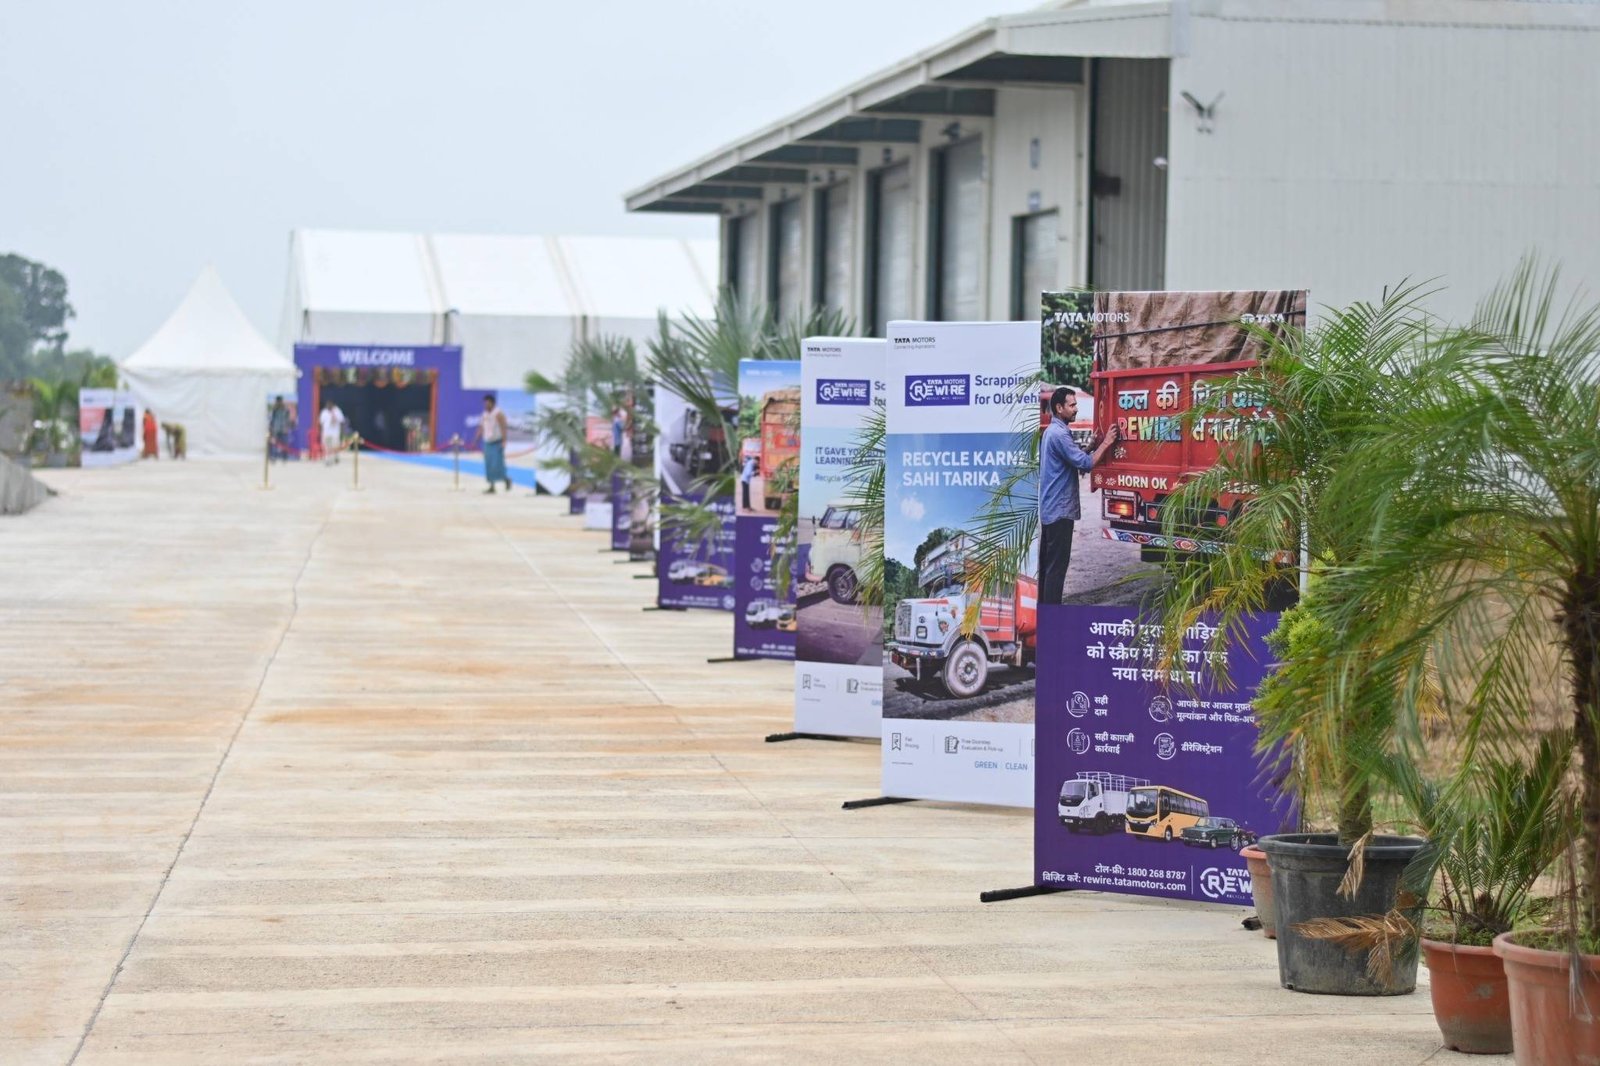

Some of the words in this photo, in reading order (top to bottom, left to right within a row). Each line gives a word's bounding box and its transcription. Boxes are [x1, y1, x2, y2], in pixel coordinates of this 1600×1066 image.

[1054, 312, 1084, 322] TATA
[1087, 312, 1130, 322] MOTORS
[339, 350, 414, 365] WELCOME
[975, 394, 990, 404] for
[994, 393, 1013, 404] Old
[1118, 390, 1149, 410] कल
[1156, 380, 1180, 410] की
[1117, 416, 1181, 441] REWIRE
[815, 447, 822, 455] IT
[824, 447, 847, 456] GAVE
[848, 448, 864, 456] YO
[902, 451, 970, 466] RECYCLE
[902, 472, 940, 487] SAHI
[943, 471, 1001, 486] TARIKA
[1117, 475, 1149, 489] HORN
[1151, 477, 1168, 490] OK
[1089, 619, 1136, 637] आपकी
[1086, 641, 1105, 660] को
[1181, 650, 1200, 663] का
[1112, 667, 1138, 681] नया
[1094, 694, 1109, 706] सही
[1176, 698, 1199, 709] आपके
[1212, 702, 1233, 711] आकर
[1094, 708, 1108, 716] दाम
[1209, 712, 1223, 722] और
[1094, 731, 1109, 742] सही
[974, 760, 998, 769] GREEN
[1005, 762, 1028, 771] CLEAN
[1127, 867, 1148, 877] 1800
[1149, 869, 1165, 878] 268
[1166, 870, 1187, 880] 8787
[1226, 868, 1250, 877] TATA
[1083, 875, 1187, 891] rewire.tatamotors.com
